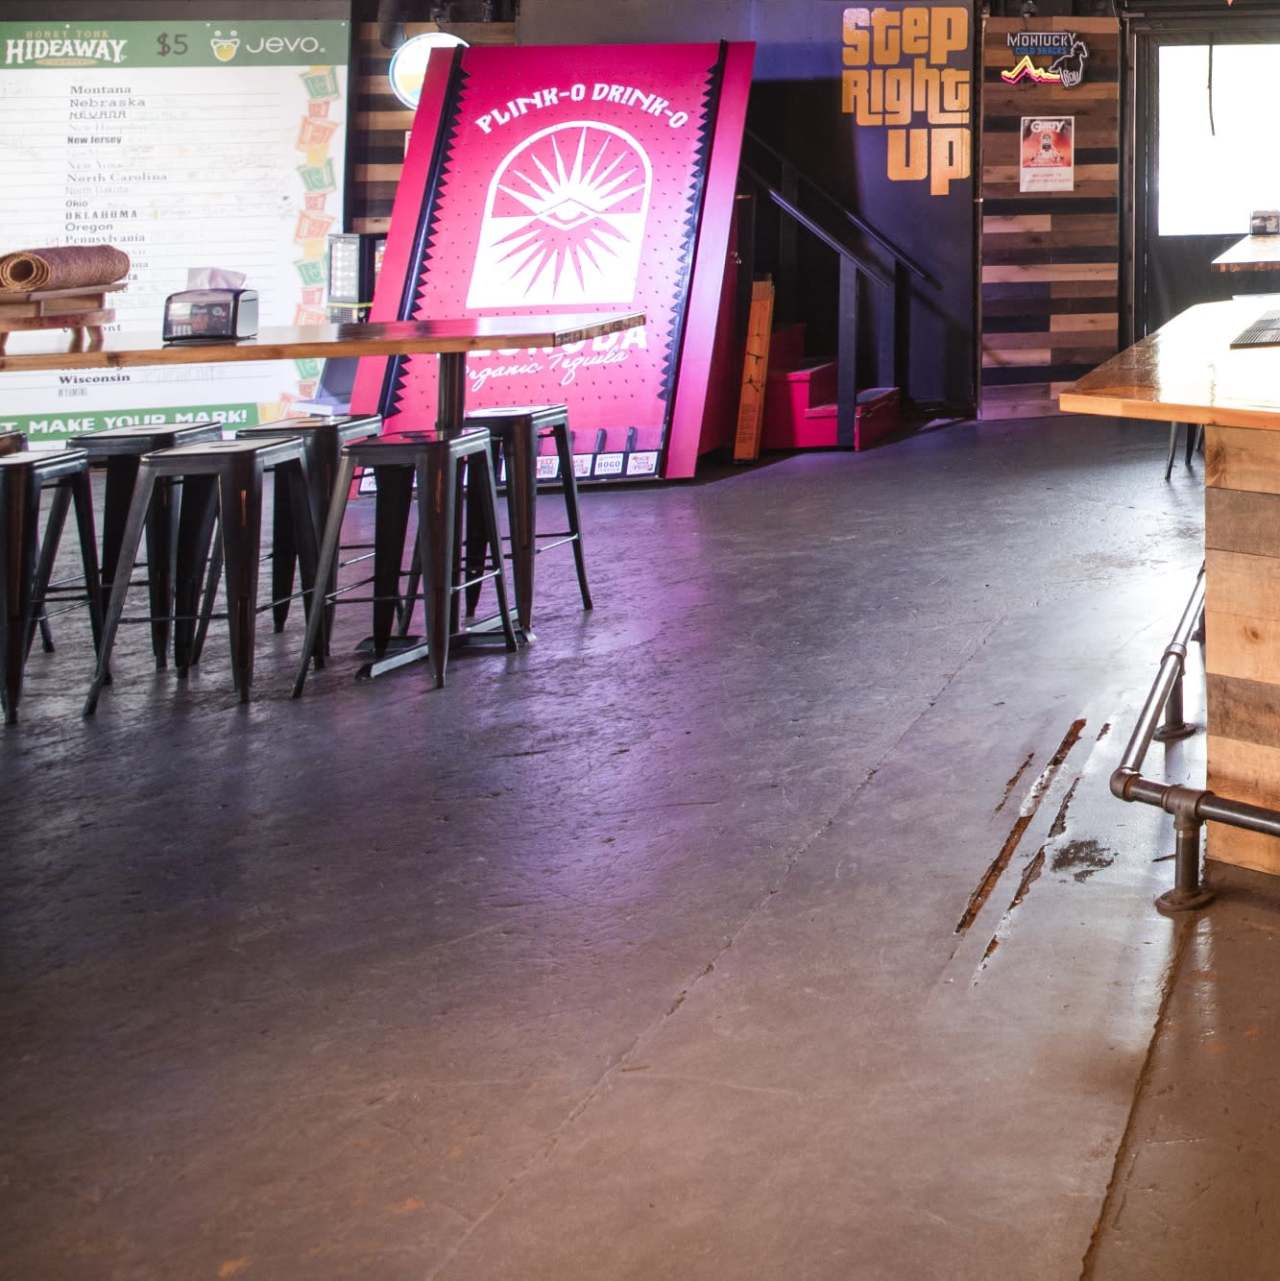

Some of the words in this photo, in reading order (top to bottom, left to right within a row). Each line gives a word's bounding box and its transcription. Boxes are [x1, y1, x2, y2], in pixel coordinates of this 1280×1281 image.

[156, 32, 189, 57] $5
[5, 39, 128, 64] HIDEAWAY
[70, 85, 132, 95] Montana
[69, 97, 146, 109] Nebraska
[474, 83, 586, 135] PLINK-O
[590, 82, 690, 130] DRINK-O
[66, 136, 89, 144] New
[109, 171, 168, 182] Carolina
[64, 221, 114, 233] Oregon
[549, 348, 629, 385] Tequila
[58, 373, 131, 385] Wisconsin
[29, 413, 96, 434] MAKE
